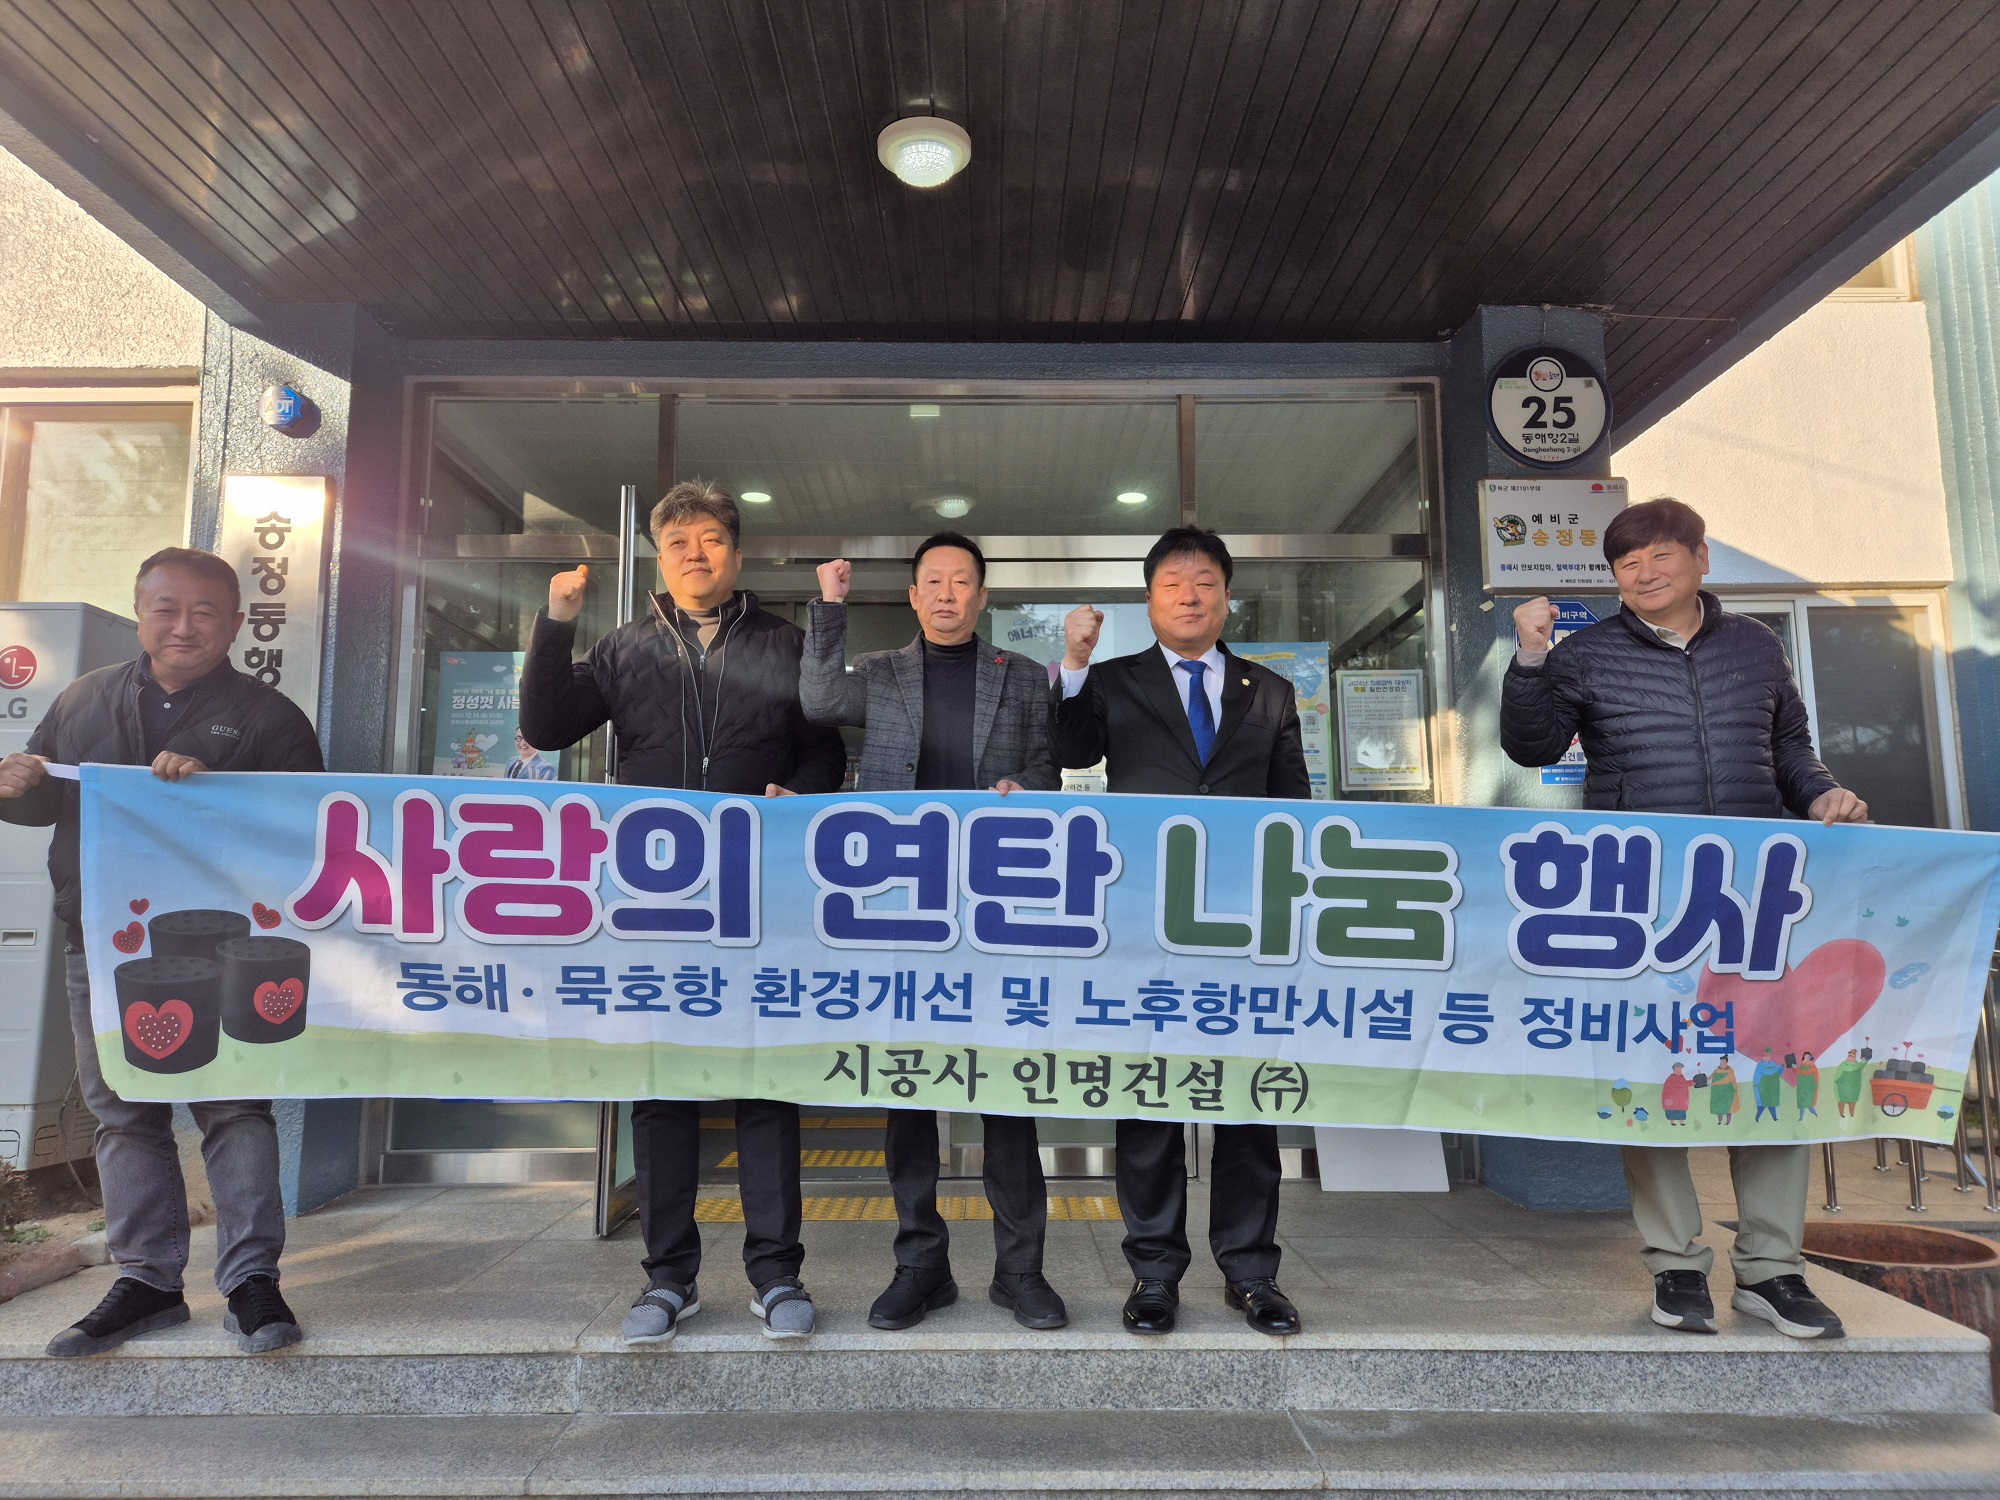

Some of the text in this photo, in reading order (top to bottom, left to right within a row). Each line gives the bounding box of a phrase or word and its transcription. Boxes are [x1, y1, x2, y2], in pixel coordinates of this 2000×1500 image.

[1521, 396, 1576, 430] 25
[1521, 433, 1580, 445] 동해항2길
[1523, 446, 1580, 455] Donghaehang 2-gil
[1500, 563, 1519, 572] 동해시
[452, 695, 494, 710] 정성껏
[290, 797, 1805, 974] 사랑의 연탄 나눔 행사
[555, 965, 729, 1018] 묵호항
[751, 967, 974, 1024] 환경개선
[1000, 975, 1049, 1029] 및
[1075, 979, 1414, 1042] 노후항만시설
[1440, 994, 1496, 1046] 등
[1518, 995, 1736, 1055] 정비사업
[823, 1043, 986, 1103] 시공사
[1011, 1051, 1225, 1112] 인명건설
